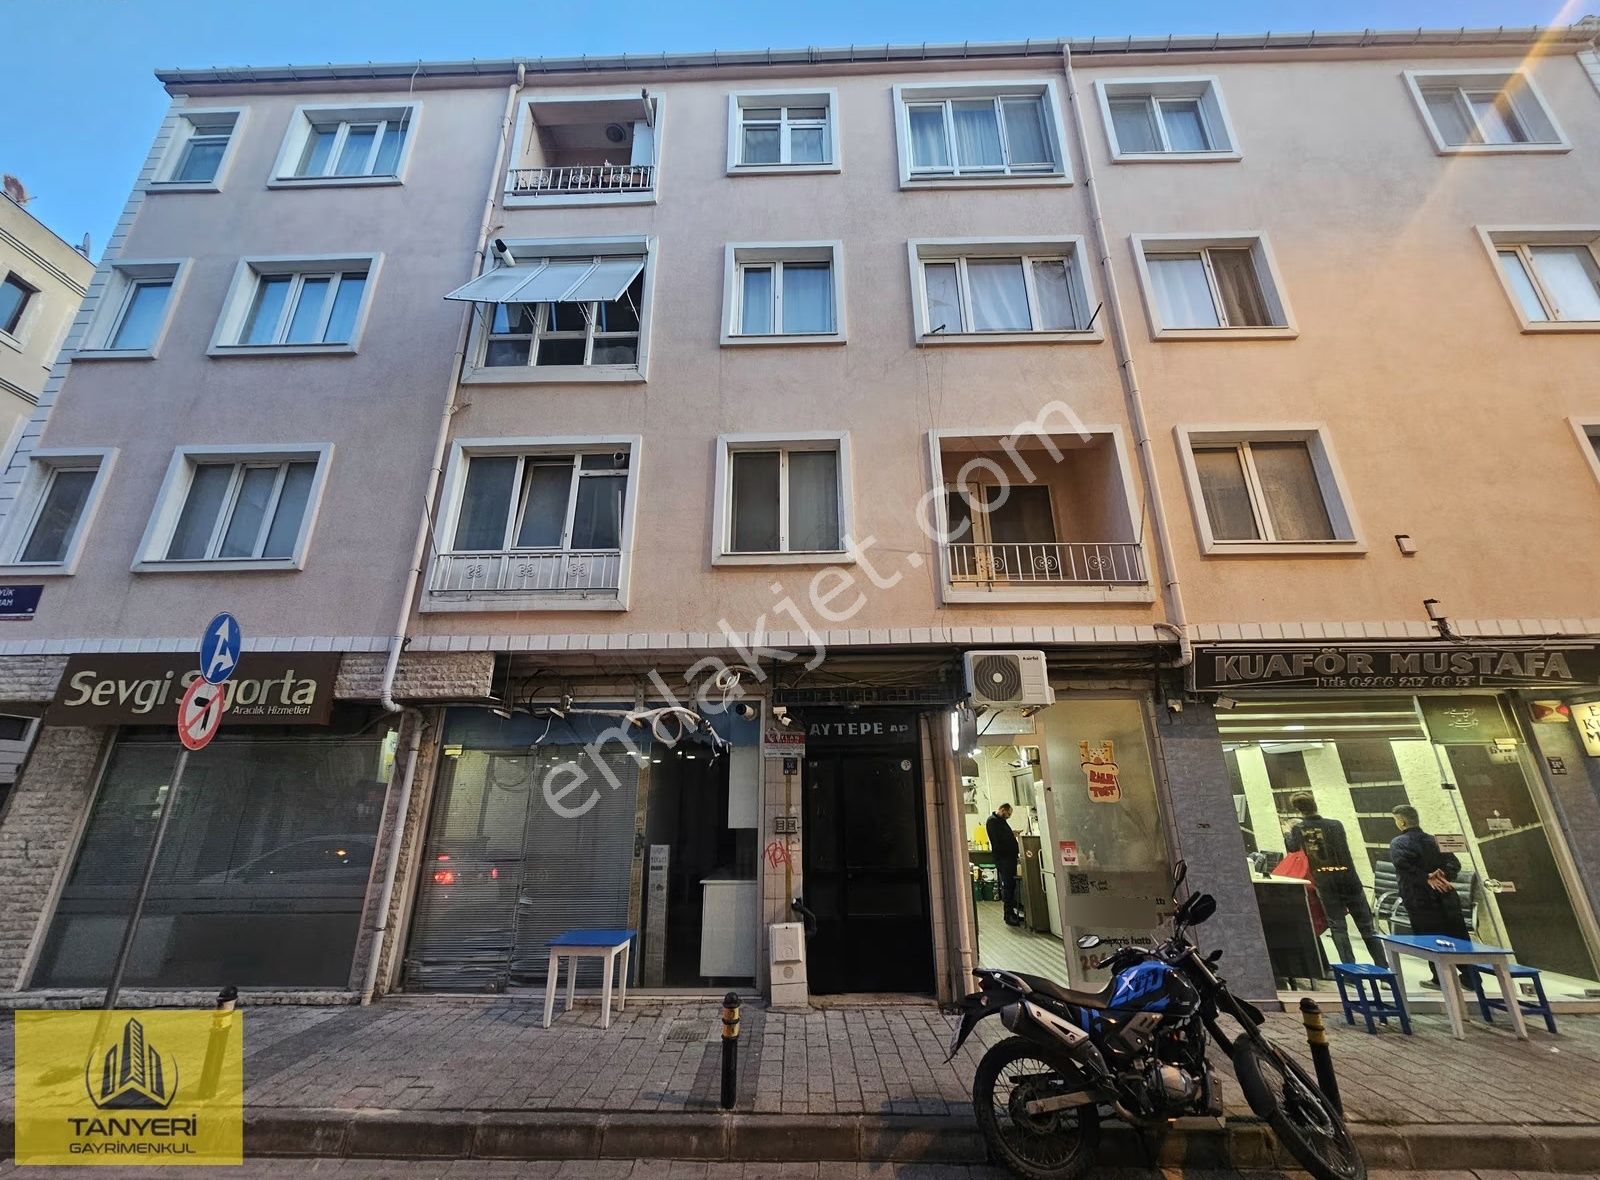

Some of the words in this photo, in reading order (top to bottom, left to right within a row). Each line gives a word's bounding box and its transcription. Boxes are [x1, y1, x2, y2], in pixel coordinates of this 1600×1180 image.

[1214, 647, 1374, 682] KUAFÖR
[1390, 651, 1573, 680] MUSTAFA
[64, 669, 174, 714] Sevgi
[176, 669, 317, 714] Sgorta
[267, 705, 311, 715] Hizmetleri
